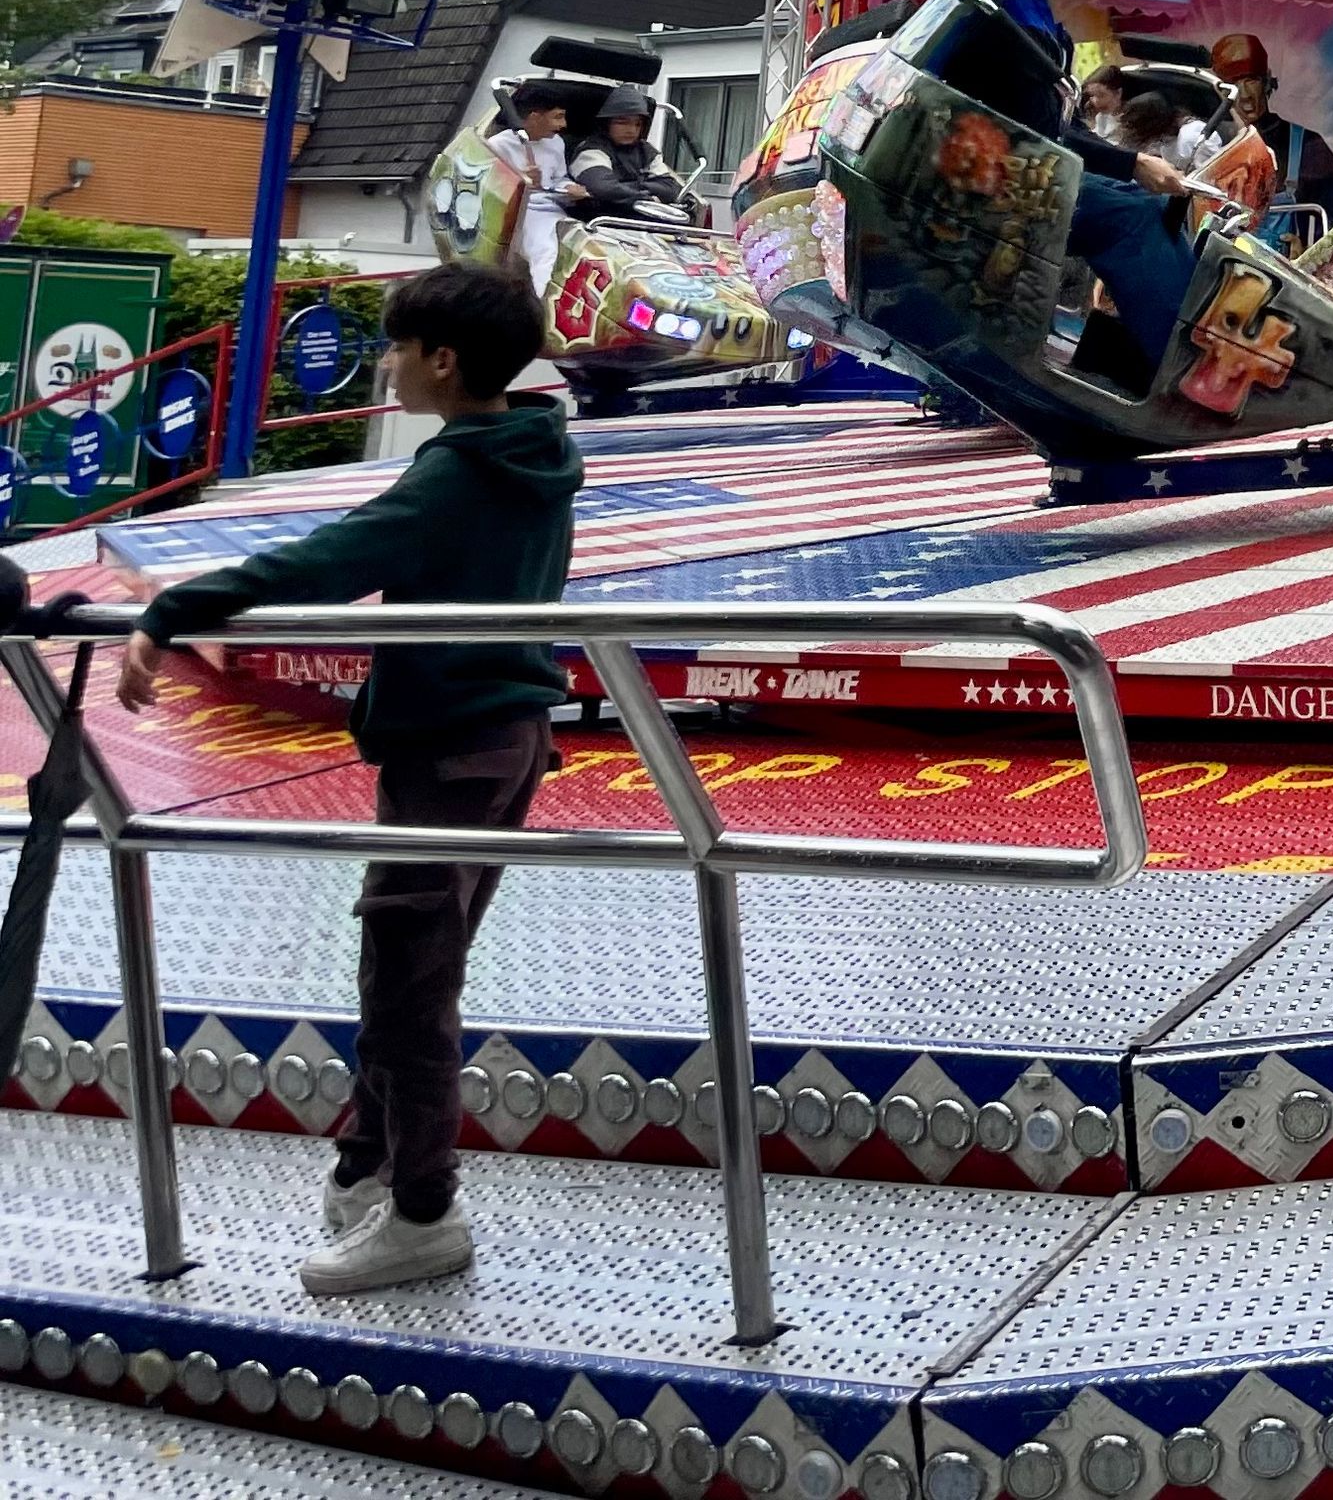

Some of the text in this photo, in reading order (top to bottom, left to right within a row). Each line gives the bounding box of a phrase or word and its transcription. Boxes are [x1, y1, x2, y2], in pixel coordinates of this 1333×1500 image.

[550, 256, 614, 345] 6
[274, 651, 372, 683] DANGE
[685, 666, 861, 701] BREAK DANCE
[543, 750, 843, 793] TOP
